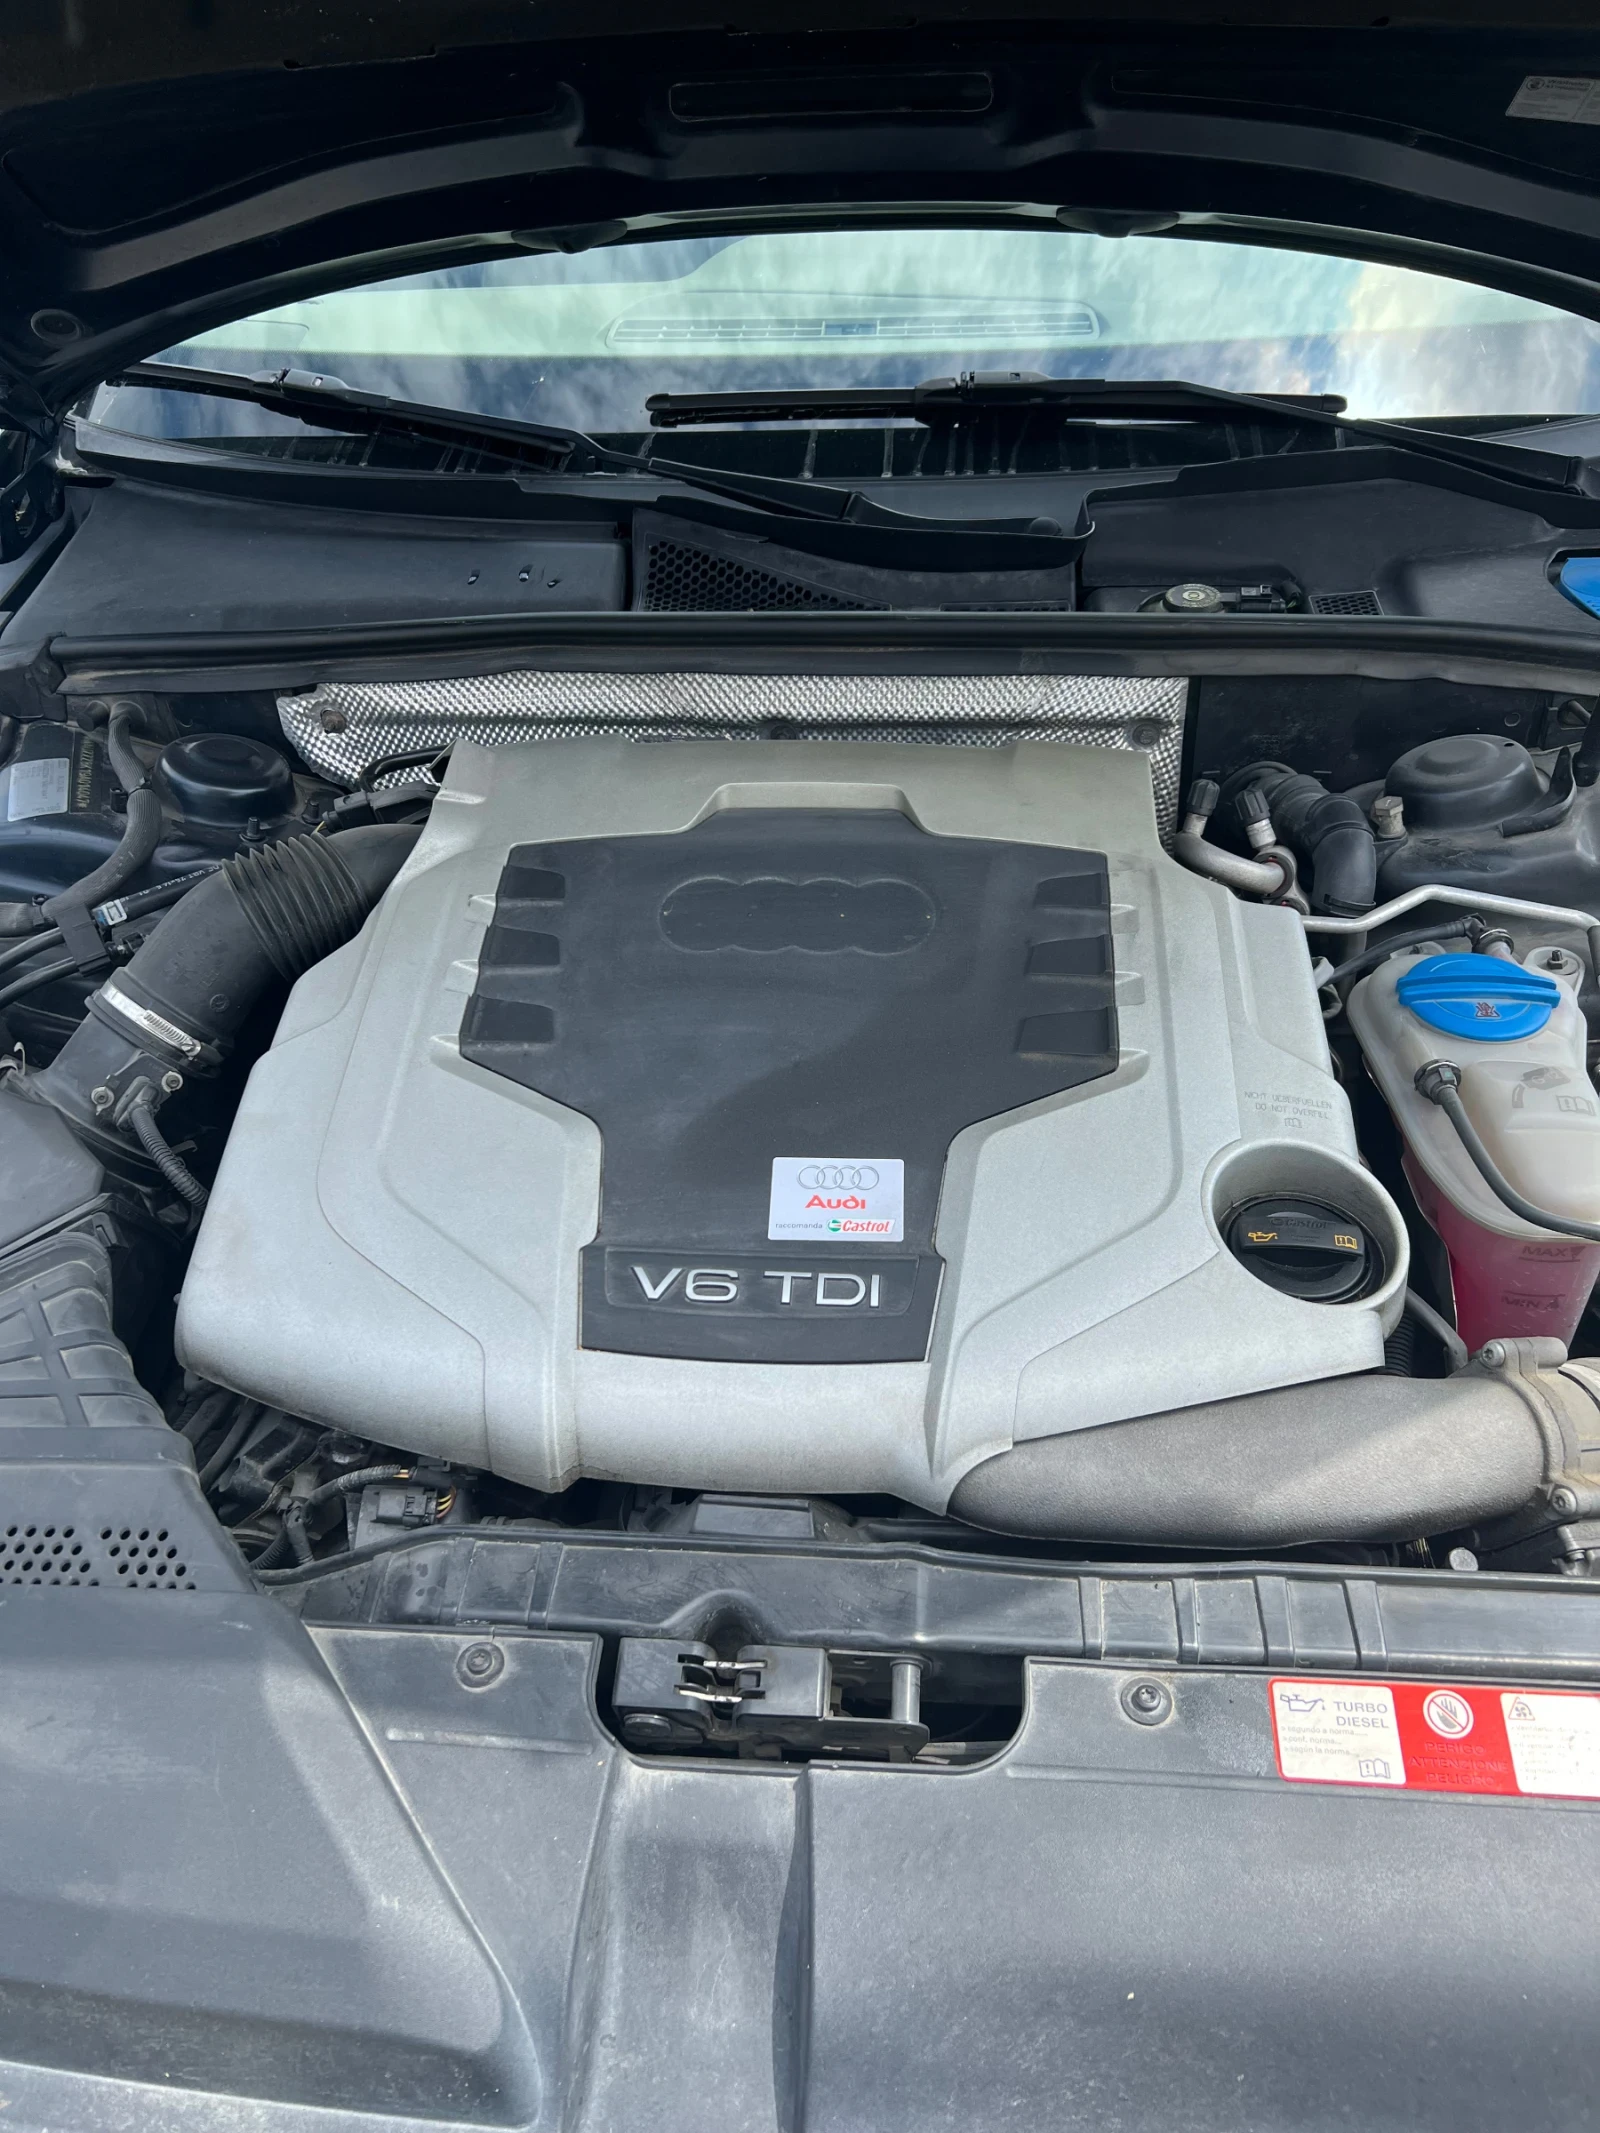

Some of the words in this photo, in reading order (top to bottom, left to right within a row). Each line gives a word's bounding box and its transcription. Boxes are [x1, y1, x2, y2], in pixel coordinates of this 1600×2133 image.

[1255, 1102, 1267, 1112] DO
[1271, 1104, 1288, 1114] NOT
[805, 1194, 866, 1210] Audi
[842, 1219, 890, 1233] Castrol
[1521, 1245, 1569, 1257] MAX
[631, 1266, 739, 1302] V6
[763, 1270, 880, 1308] TDI
[1333, 1700, 1388, 1714] TURBO
[1335, 1715, 1390, 1729] DIESEL
[1425, 1741, 1486, 1756] PERIGO
[1409, 1756, 1509, 1774] ATTENZIONE
[1426, 1772, 1495, 1786] PELIGRO
